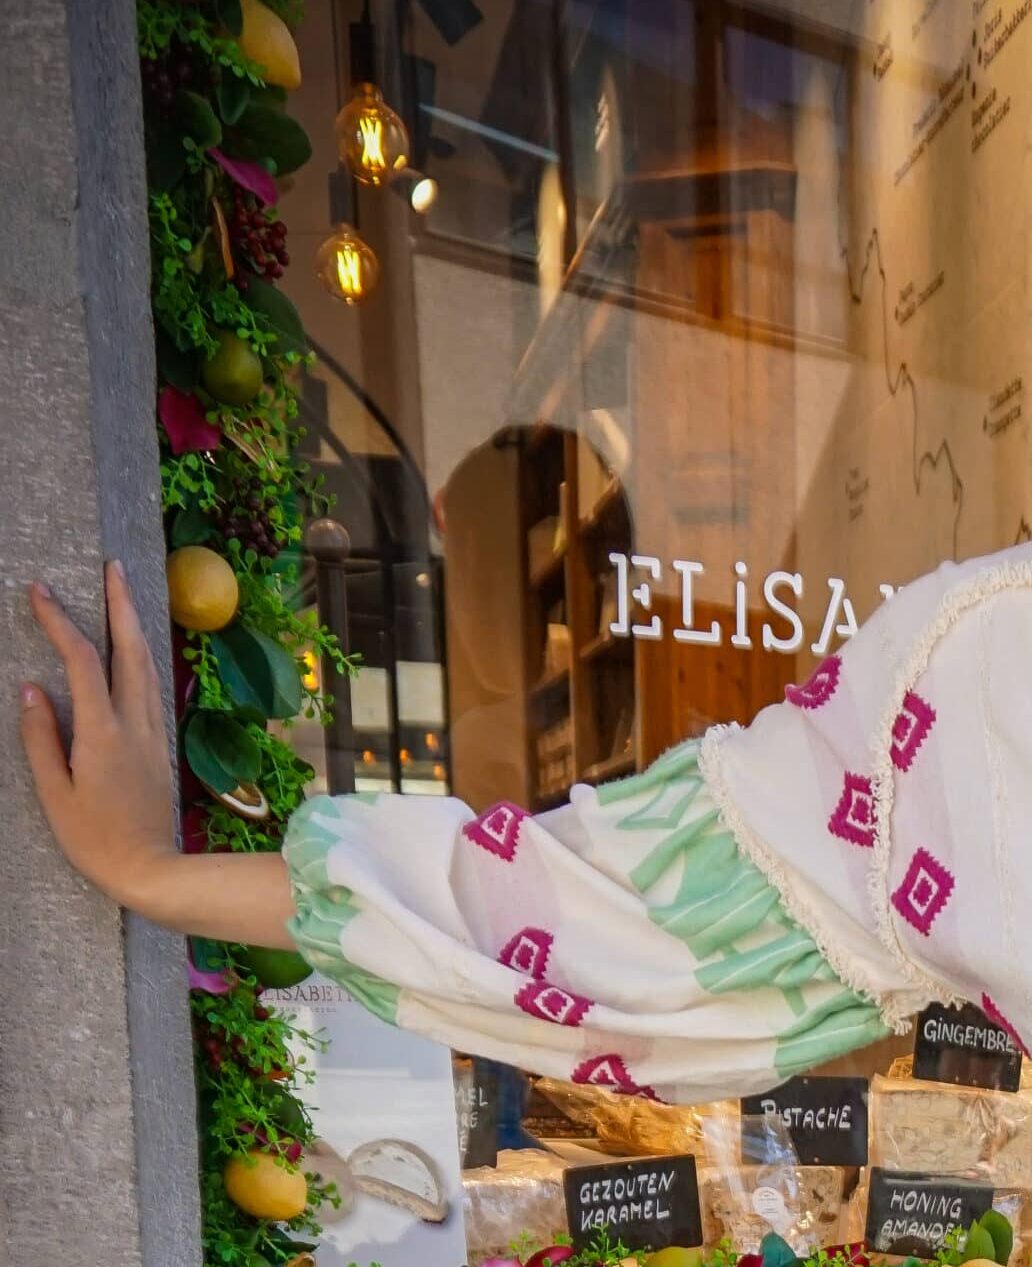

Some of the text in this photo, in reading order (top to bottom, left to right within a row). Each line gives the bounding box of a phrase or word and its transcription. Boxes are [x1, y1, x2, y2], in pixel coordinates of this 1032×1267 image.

[579, 1170, 677, 1205] GEZOUTEN
[579, 1198, 671, 1232] KARAMEL
[889, 1189, 963, 1220] HONING
[880, 1218, 963, 1240] AMANDE
